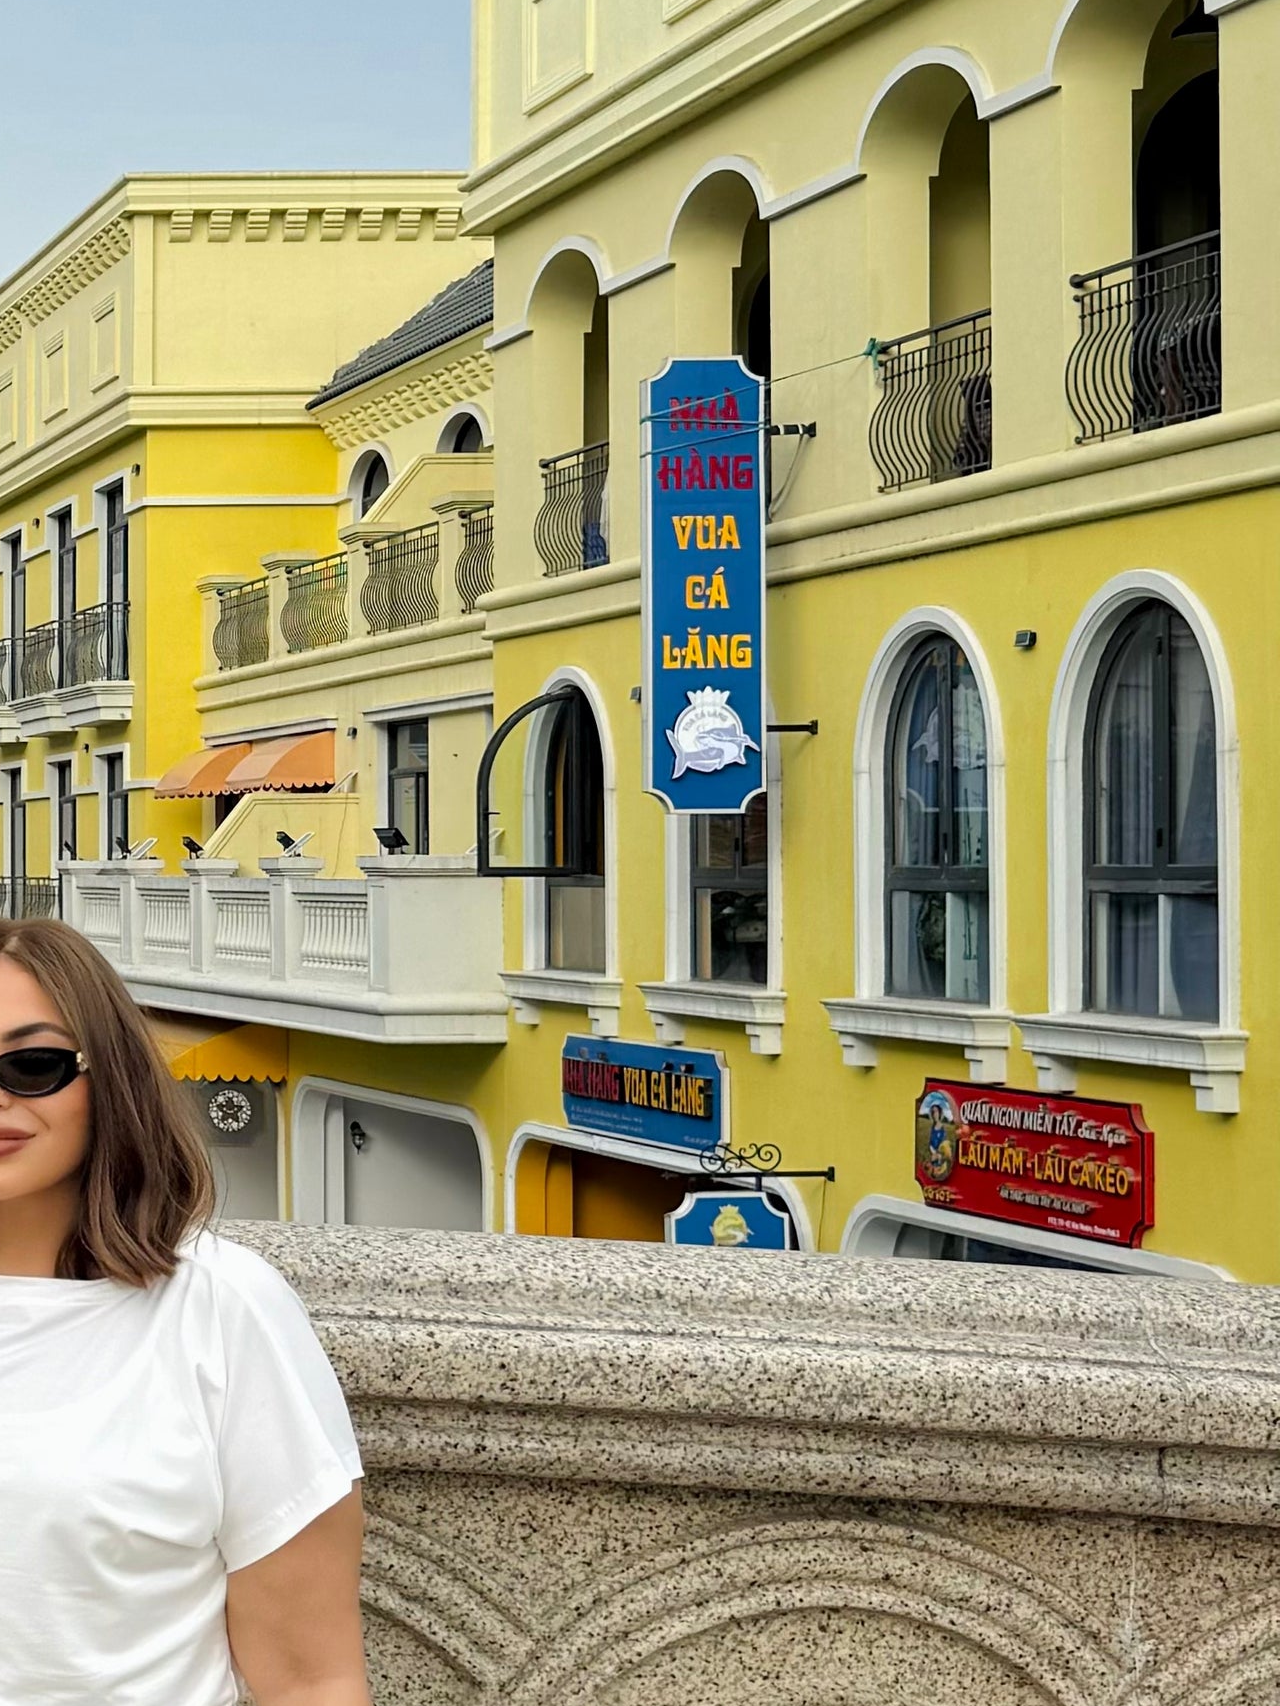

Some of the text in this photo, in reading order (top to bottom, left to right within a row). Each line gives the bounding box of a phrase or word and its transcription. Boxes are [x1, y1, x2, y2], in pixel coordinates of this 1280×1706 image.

[669, 386, 742, 431] NHÀ
[656, 447, 753, 490] HÀNG
[671, 514, 740, 550] VUA
[684, 565, 730, 610] CÁ
[662, 626, 752, 669] LĂNG
[623, 1066, 649, 1107] VUA
[960, 1098, 990, 1124] QUÁN
[990, 1106, 1022, 1129] NGON
